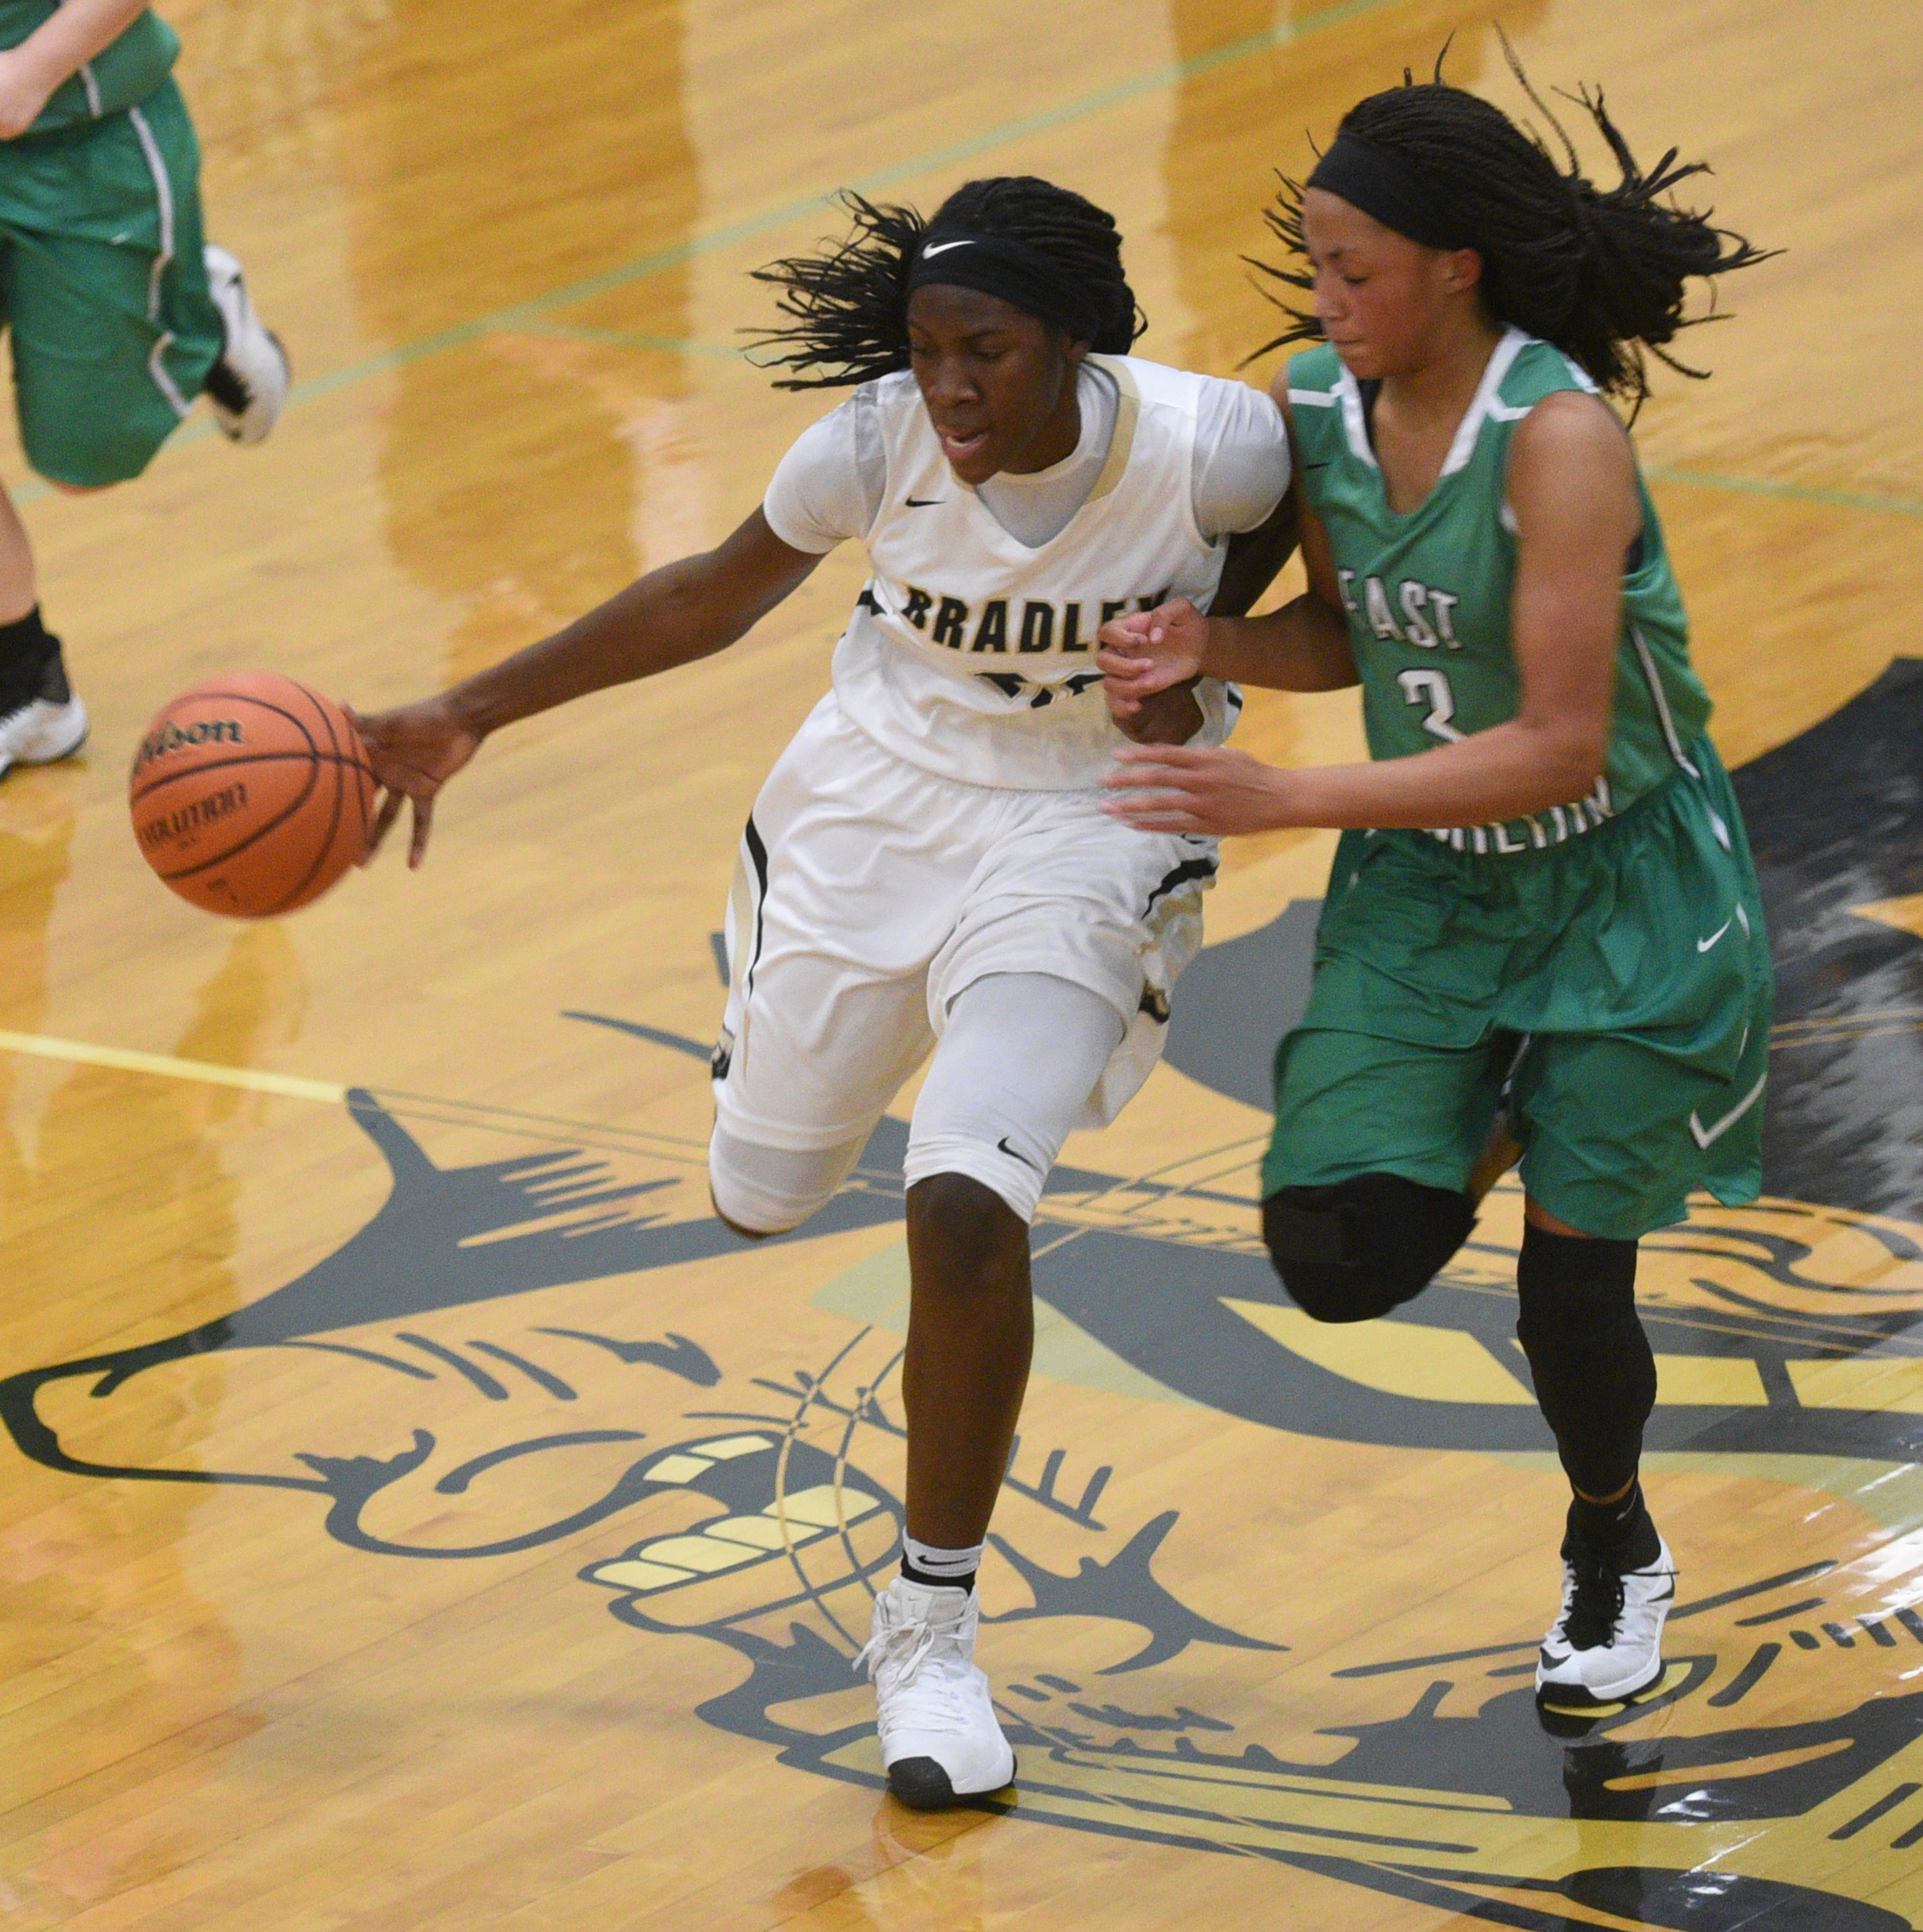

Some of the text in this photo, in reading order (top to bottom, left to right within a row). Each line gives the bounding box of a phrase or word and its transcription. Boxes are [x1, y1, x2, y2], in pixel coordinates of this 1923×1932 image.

[1338, 568, 1463, 650] EAST
[132, 718, 245, 773] ilson
[134, 782, 249, 848] VOLUTION
